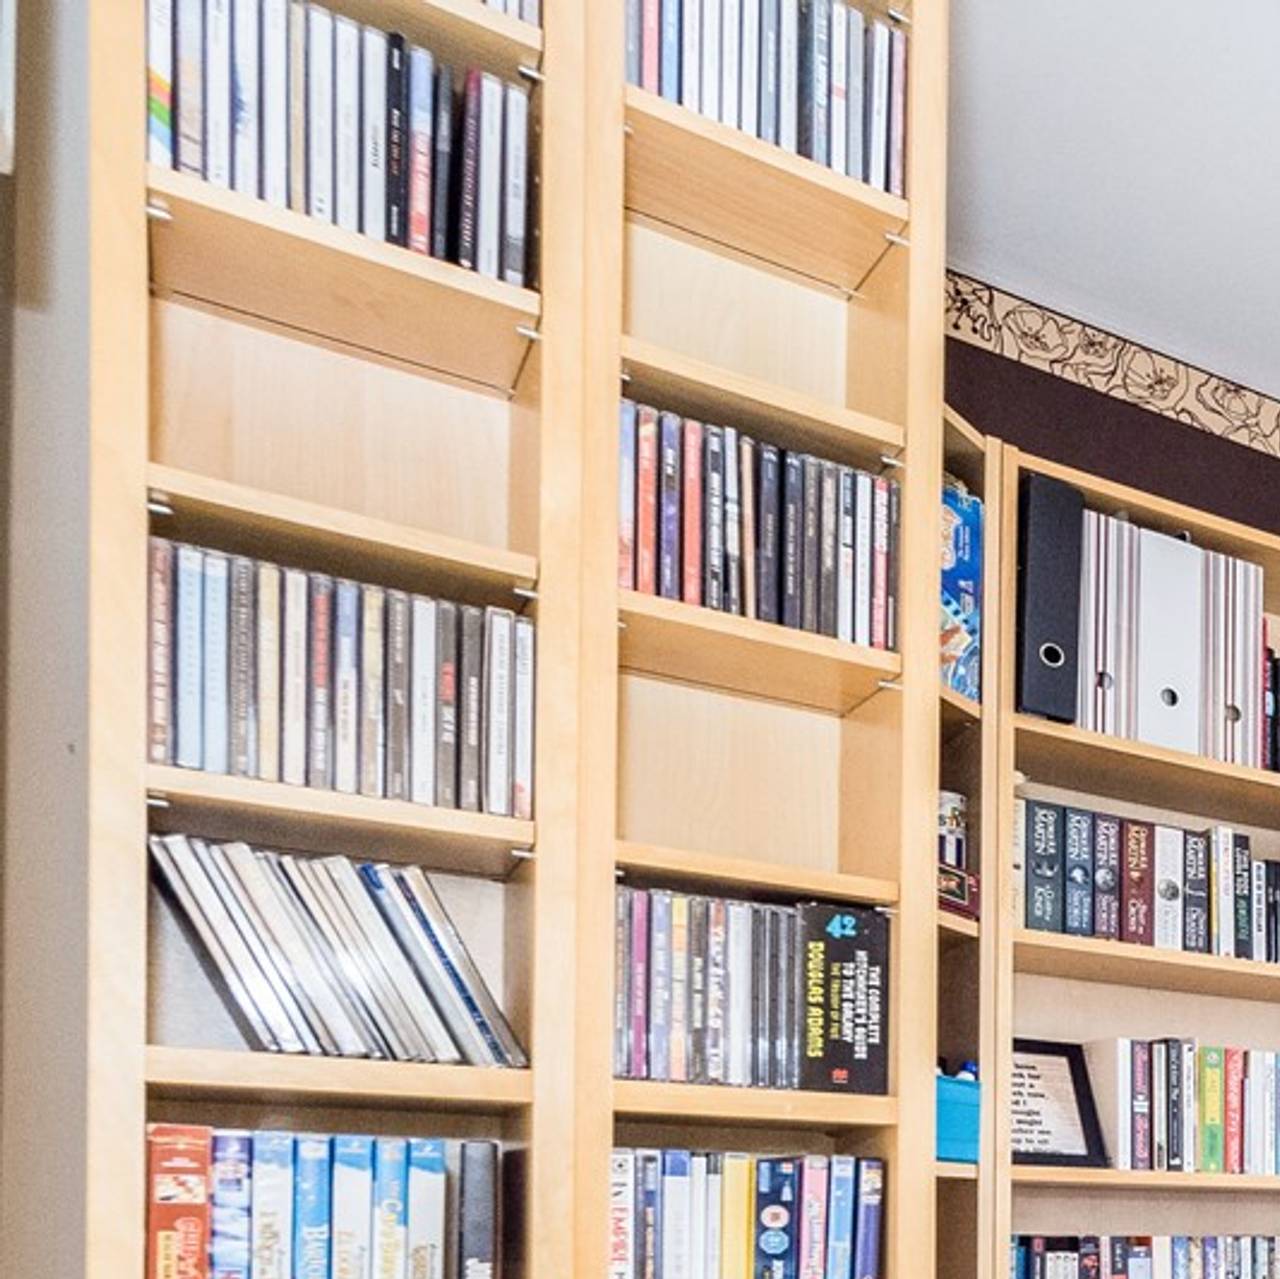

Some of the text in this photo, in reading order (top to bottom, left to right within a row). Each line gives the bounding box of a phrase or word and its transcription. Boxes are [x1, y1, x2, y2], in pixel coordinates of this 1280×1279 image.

[1034, 807, 1048, 854] MARTIN
[1068, 813, 1082, 860] MARTIN
[1097, 820, 1110, 866] MARTIN
[1128, 825, 1140, 868] MARTIN
[1187, 836, 1198, 879] MARTIN
[826, 914, 858, 938] 42
[807, 941, 824, 1058] DOUGLAS ADAMS
[841, 962, 855, 1043] TO THE GALAXY
[867, 966, 880, 1043] THE COMPLETE
[854, 1027, 868, 1060] GUIDE
[612, 1208, 629, 1262] EMPIRE
